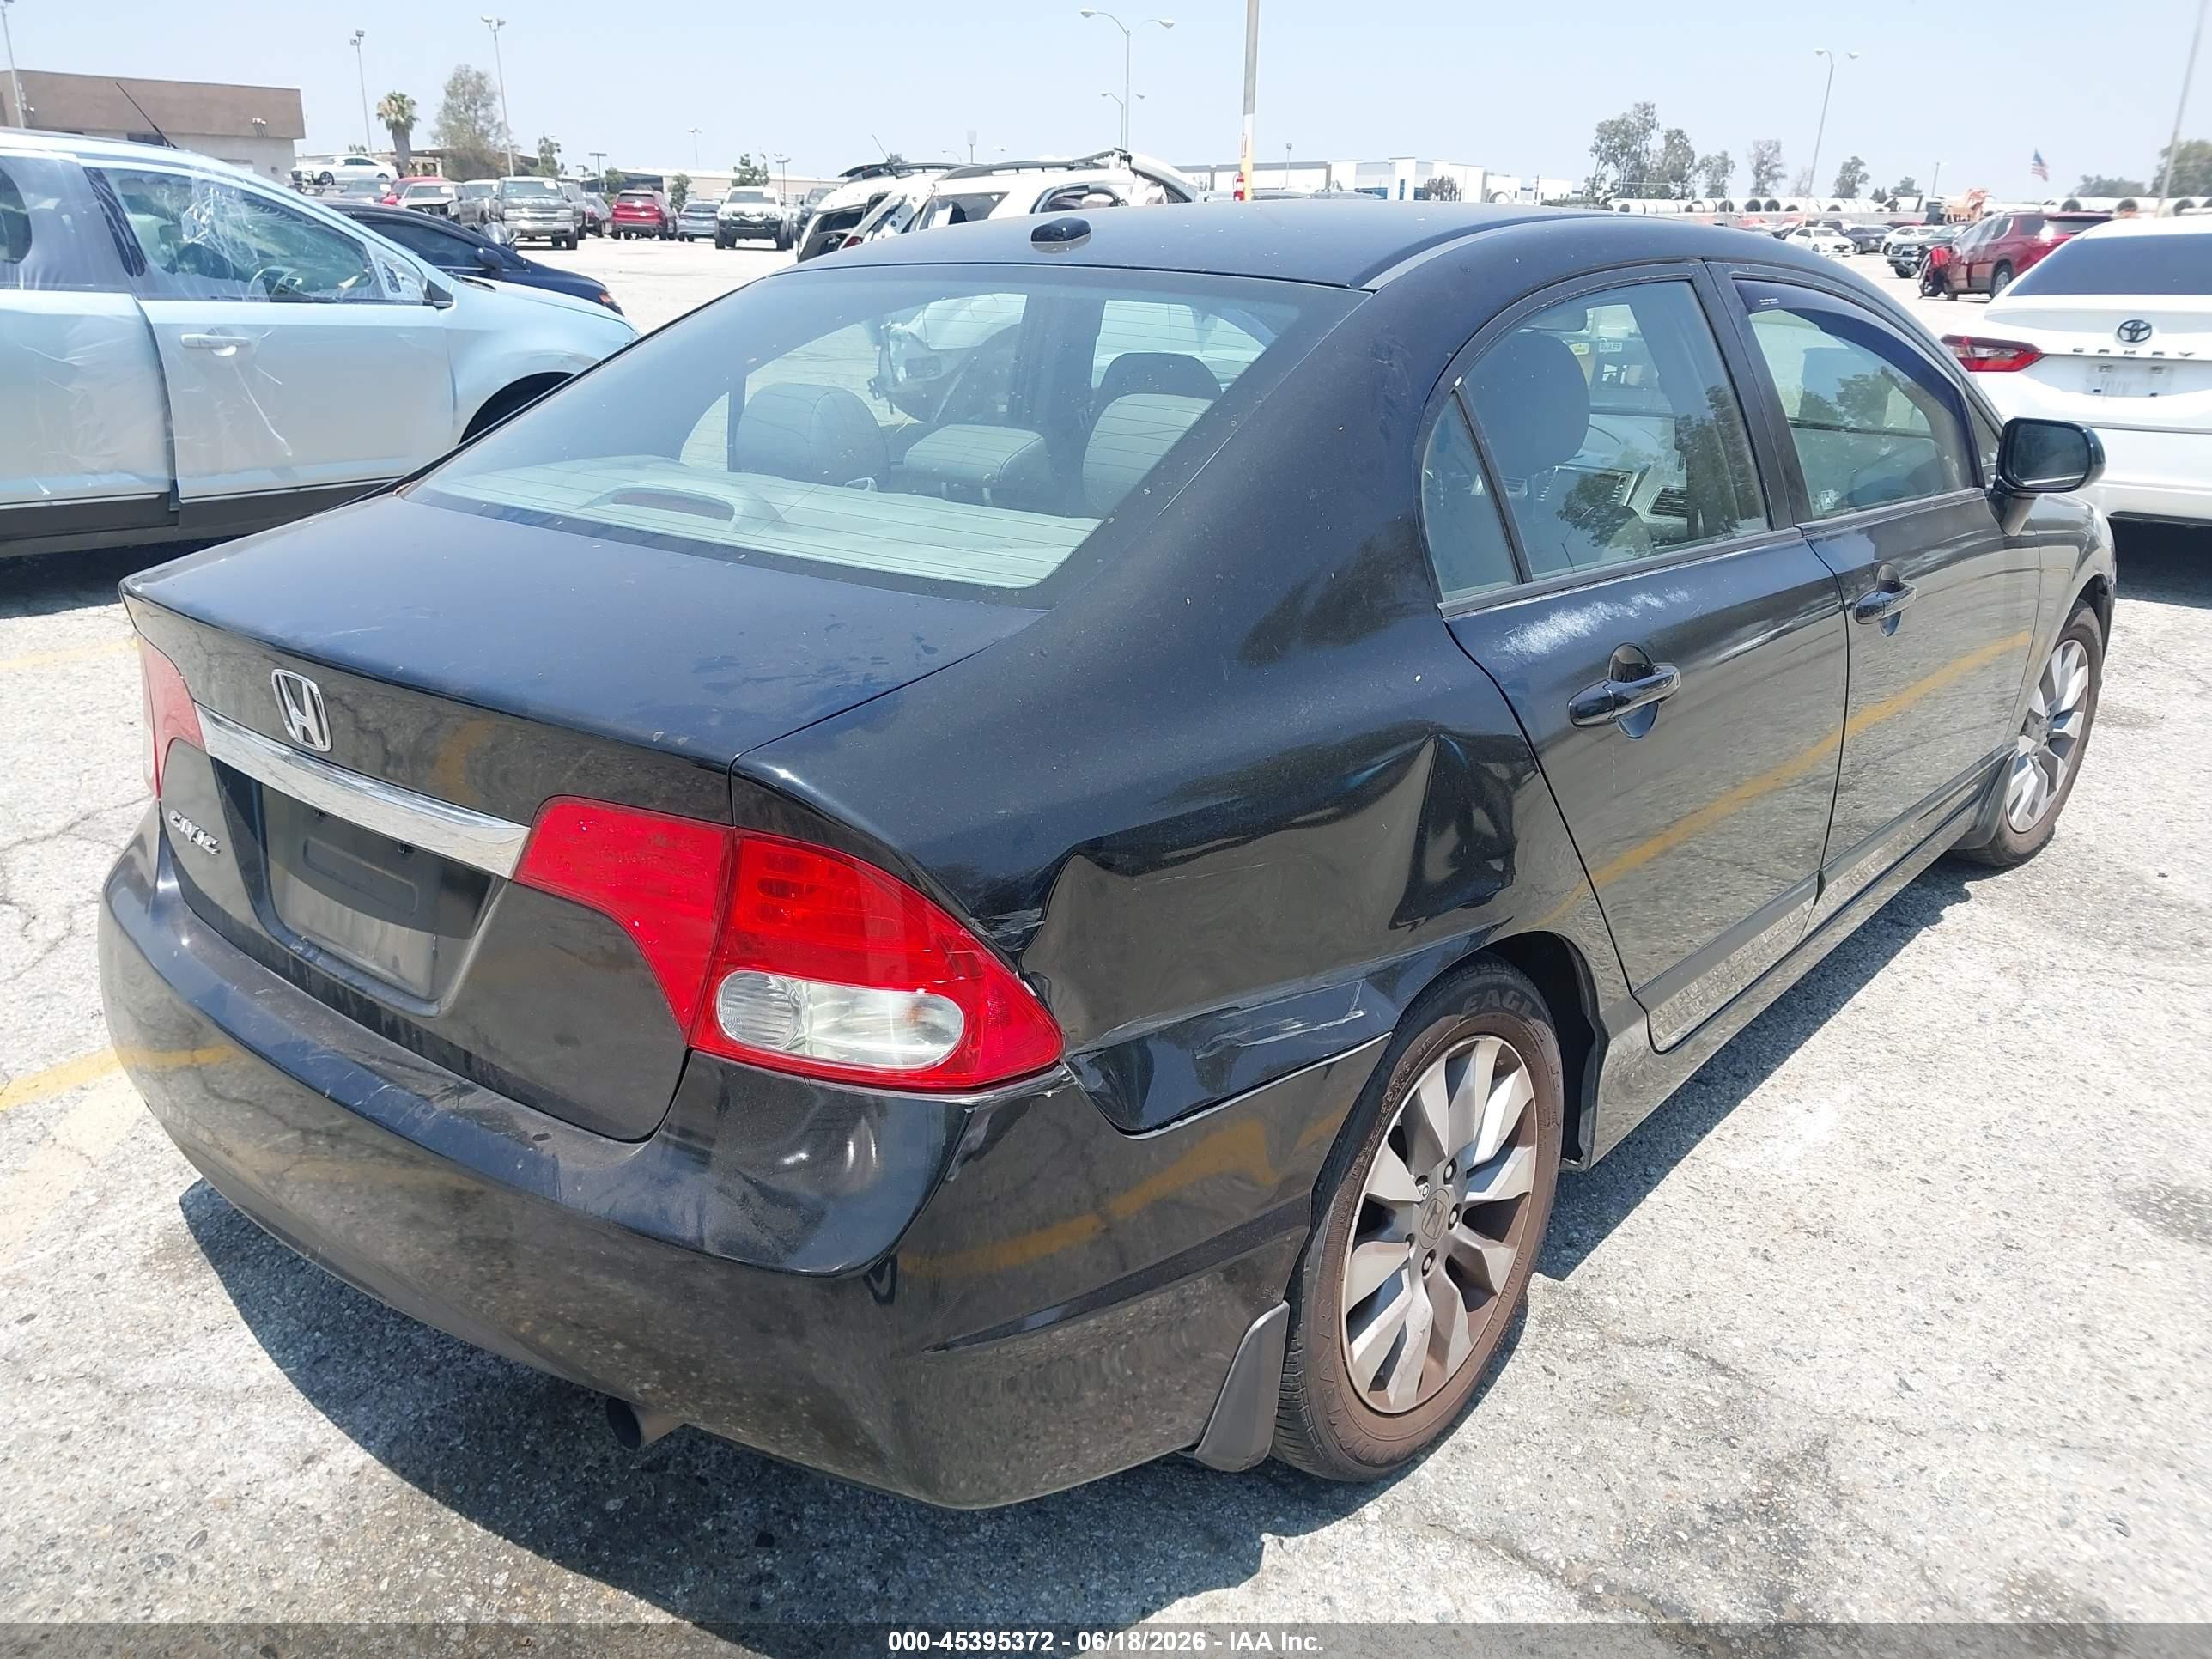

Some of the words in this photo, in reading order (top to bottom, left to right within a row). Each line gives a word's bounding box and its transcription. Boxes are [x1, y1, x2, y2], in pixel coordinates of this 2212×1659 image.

[2072, 347, 2196, 357] CAMRY
[169, 810, 221, 855] CIVIC
[1461, 988, 1549, 1045] EAGLE
